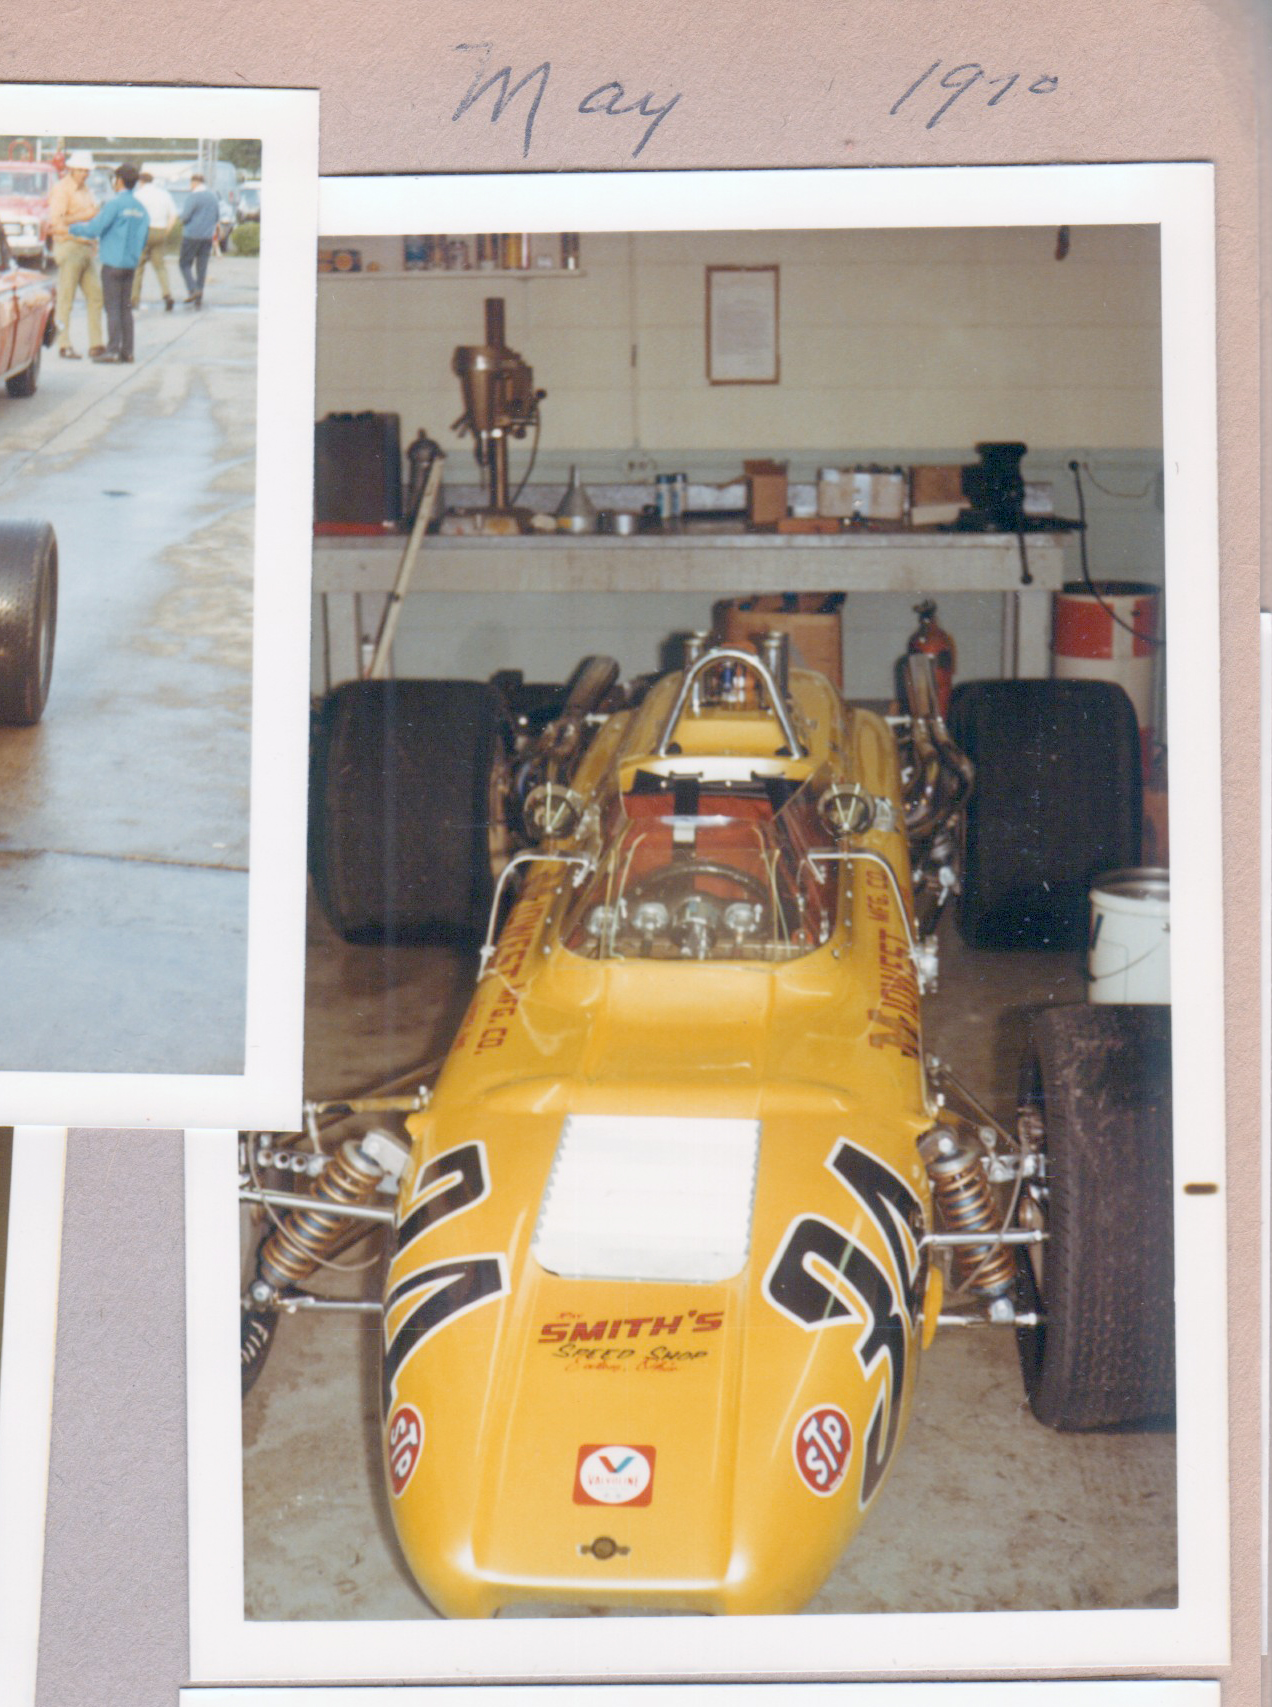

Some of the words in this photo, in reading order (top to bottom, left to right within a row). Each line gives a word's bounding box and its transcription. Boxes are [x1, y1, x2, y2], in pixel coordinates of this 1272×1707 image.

[450, 43, 685, 159] May
[538, 1310, 724, 1344] SMITH'S
[390, 1416, 418, 1477] STP
[803, 1415, 842, 1485] STP
